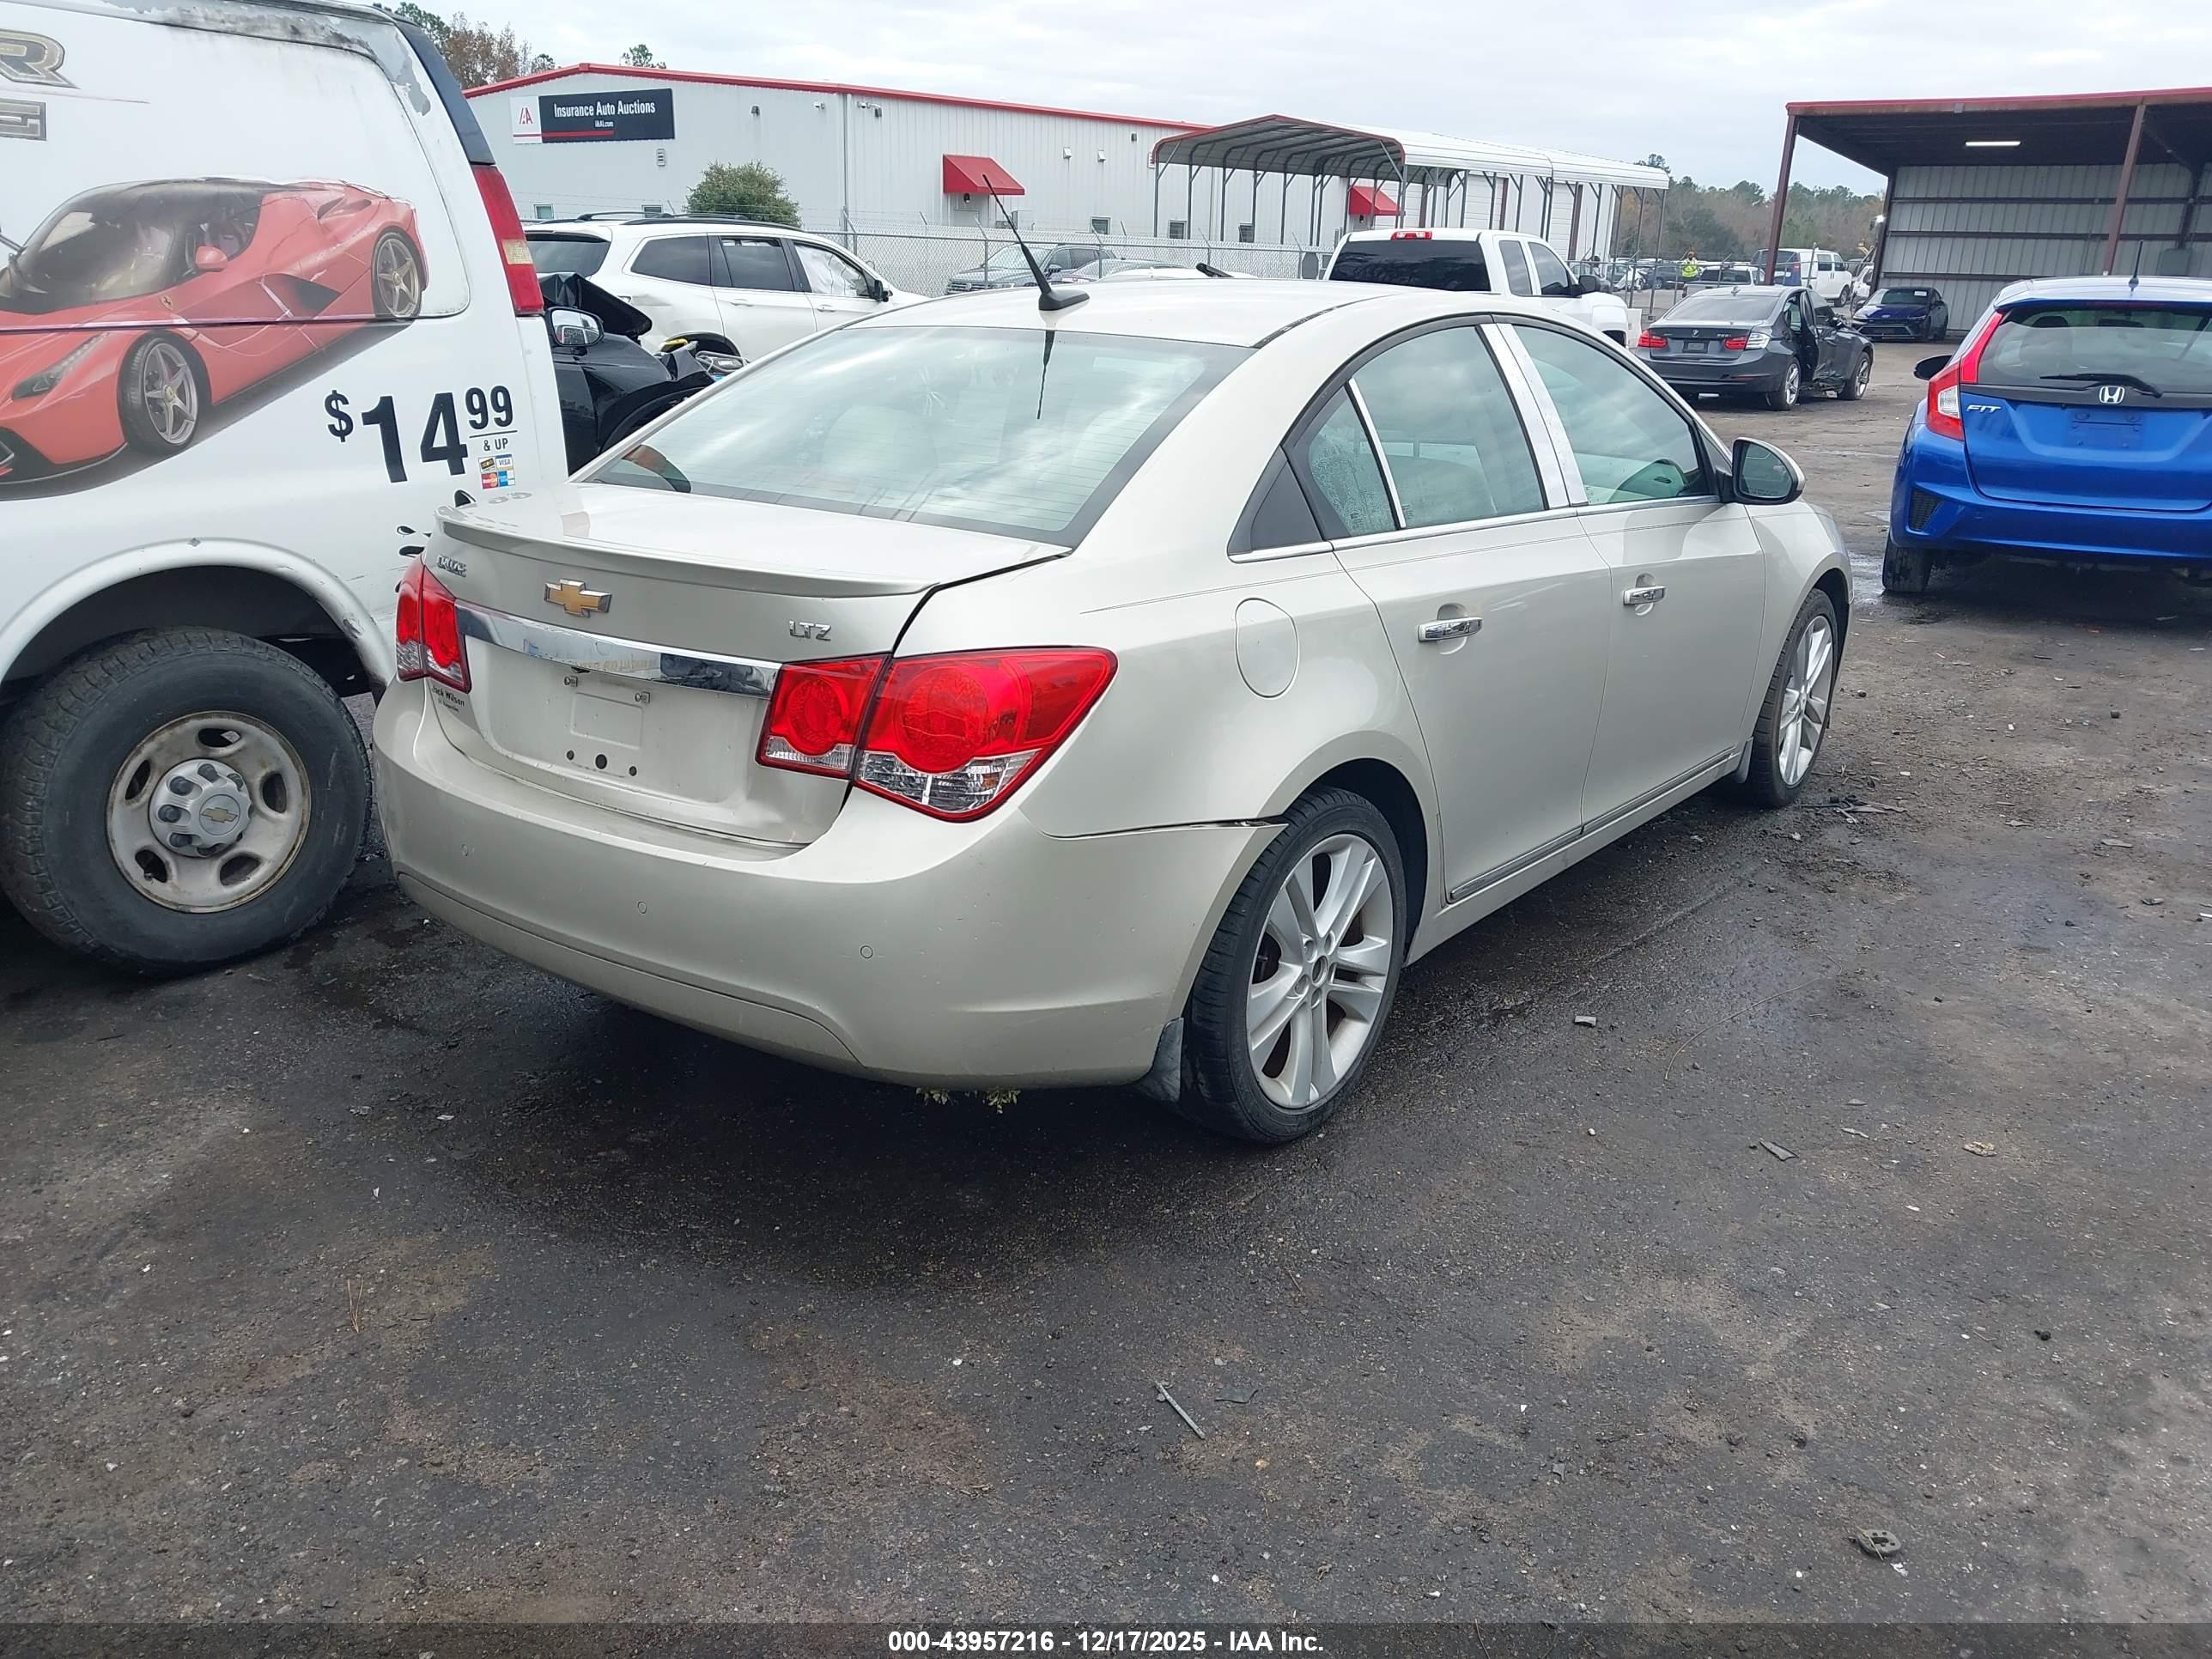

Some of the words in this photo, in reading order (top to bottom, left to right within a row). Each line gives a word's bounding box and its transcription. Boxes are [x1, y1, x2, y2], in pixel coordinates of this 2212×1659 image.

[554, 102, 594, 118] Insurance
[596, 100, 616, 115] Auto
[617, 98, 656, 115] Auctions
[1966, 404, 2002, 413] FIT
[483, 440, 490, 451] &
[495, 438, 508, 450] UP
[789, 620, 831, 641] LTZ
[445, 690, 465, 707] Wilson
